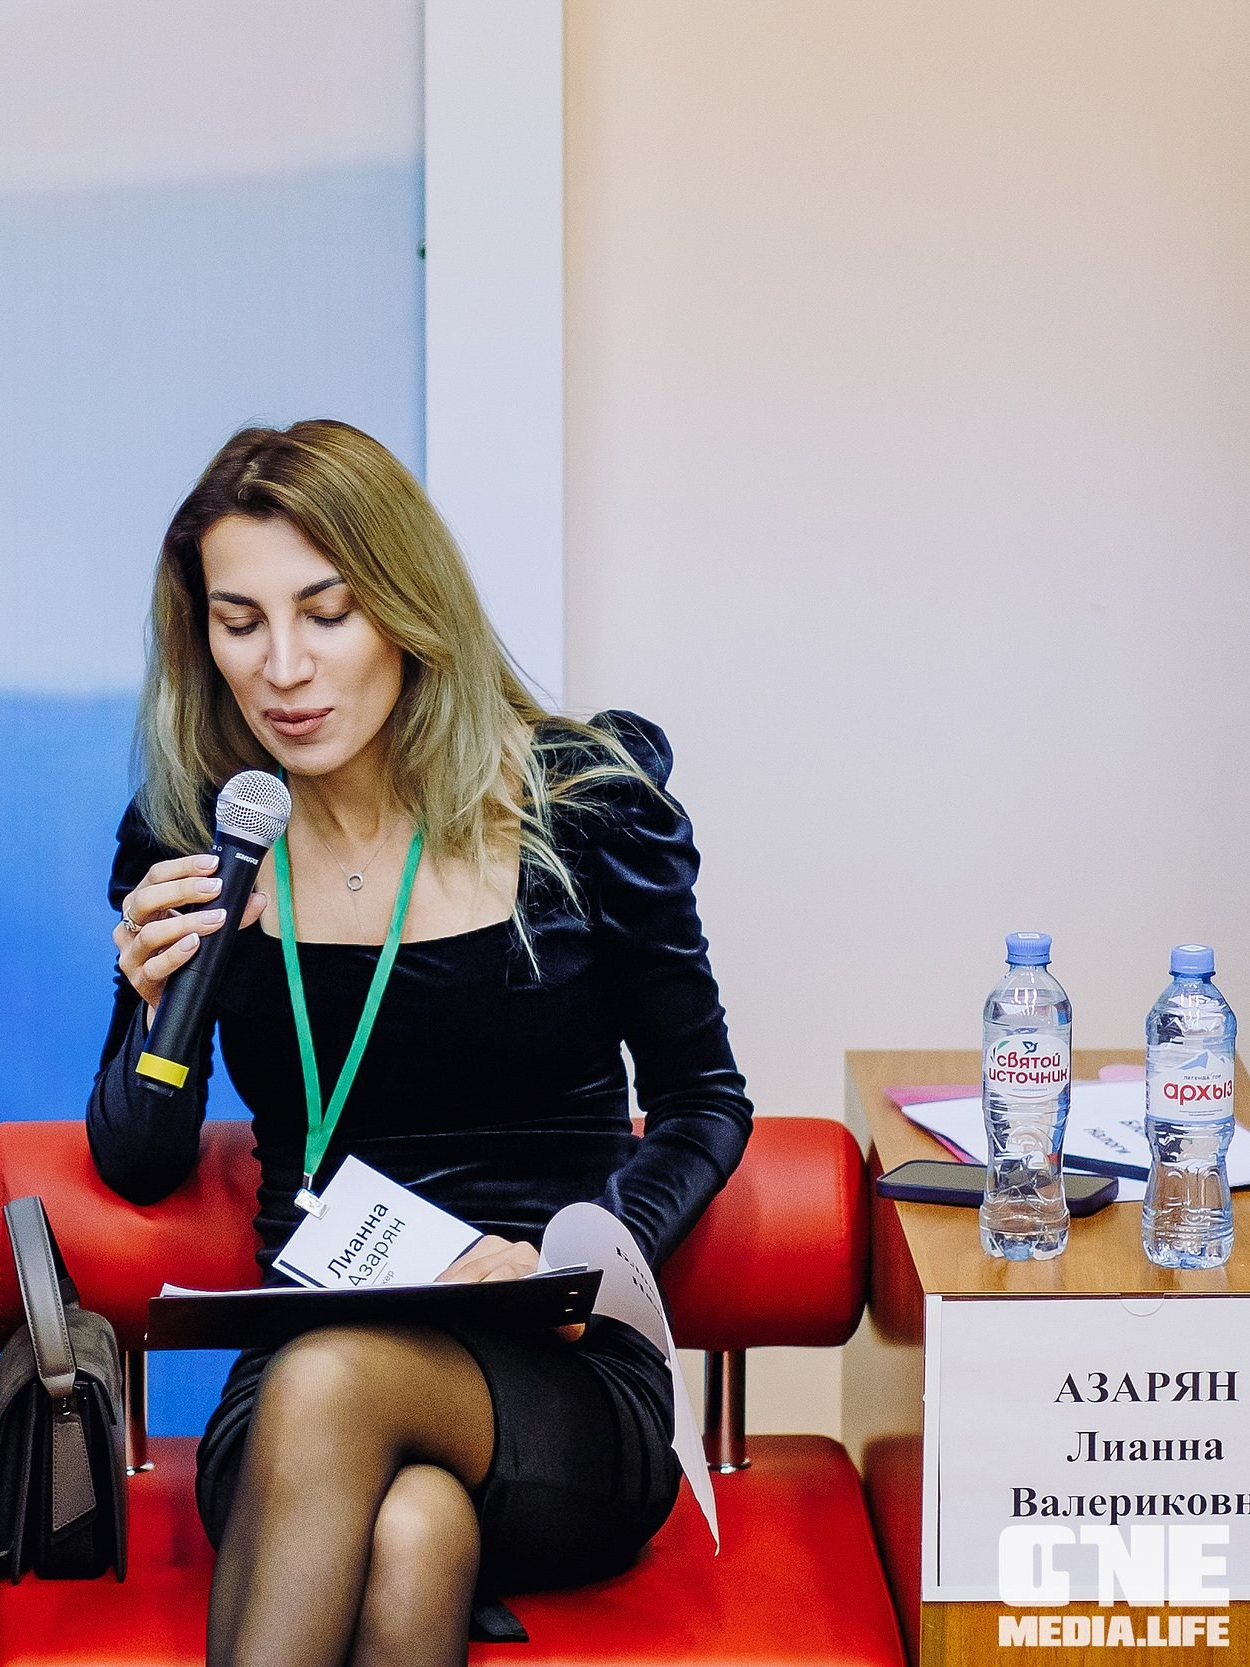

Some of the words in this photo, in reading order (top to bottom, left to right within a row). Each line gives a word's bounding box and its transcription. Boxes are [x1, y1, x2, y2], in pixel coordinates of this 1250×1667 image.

[327, 1203, 389, 1279] Лианна
[348, 1217, 406, 1286] Азарян
[1054, 1371, 1240, 1403] АЗАРЯН
[1066, 1431, 1225, 1462] Лианна
